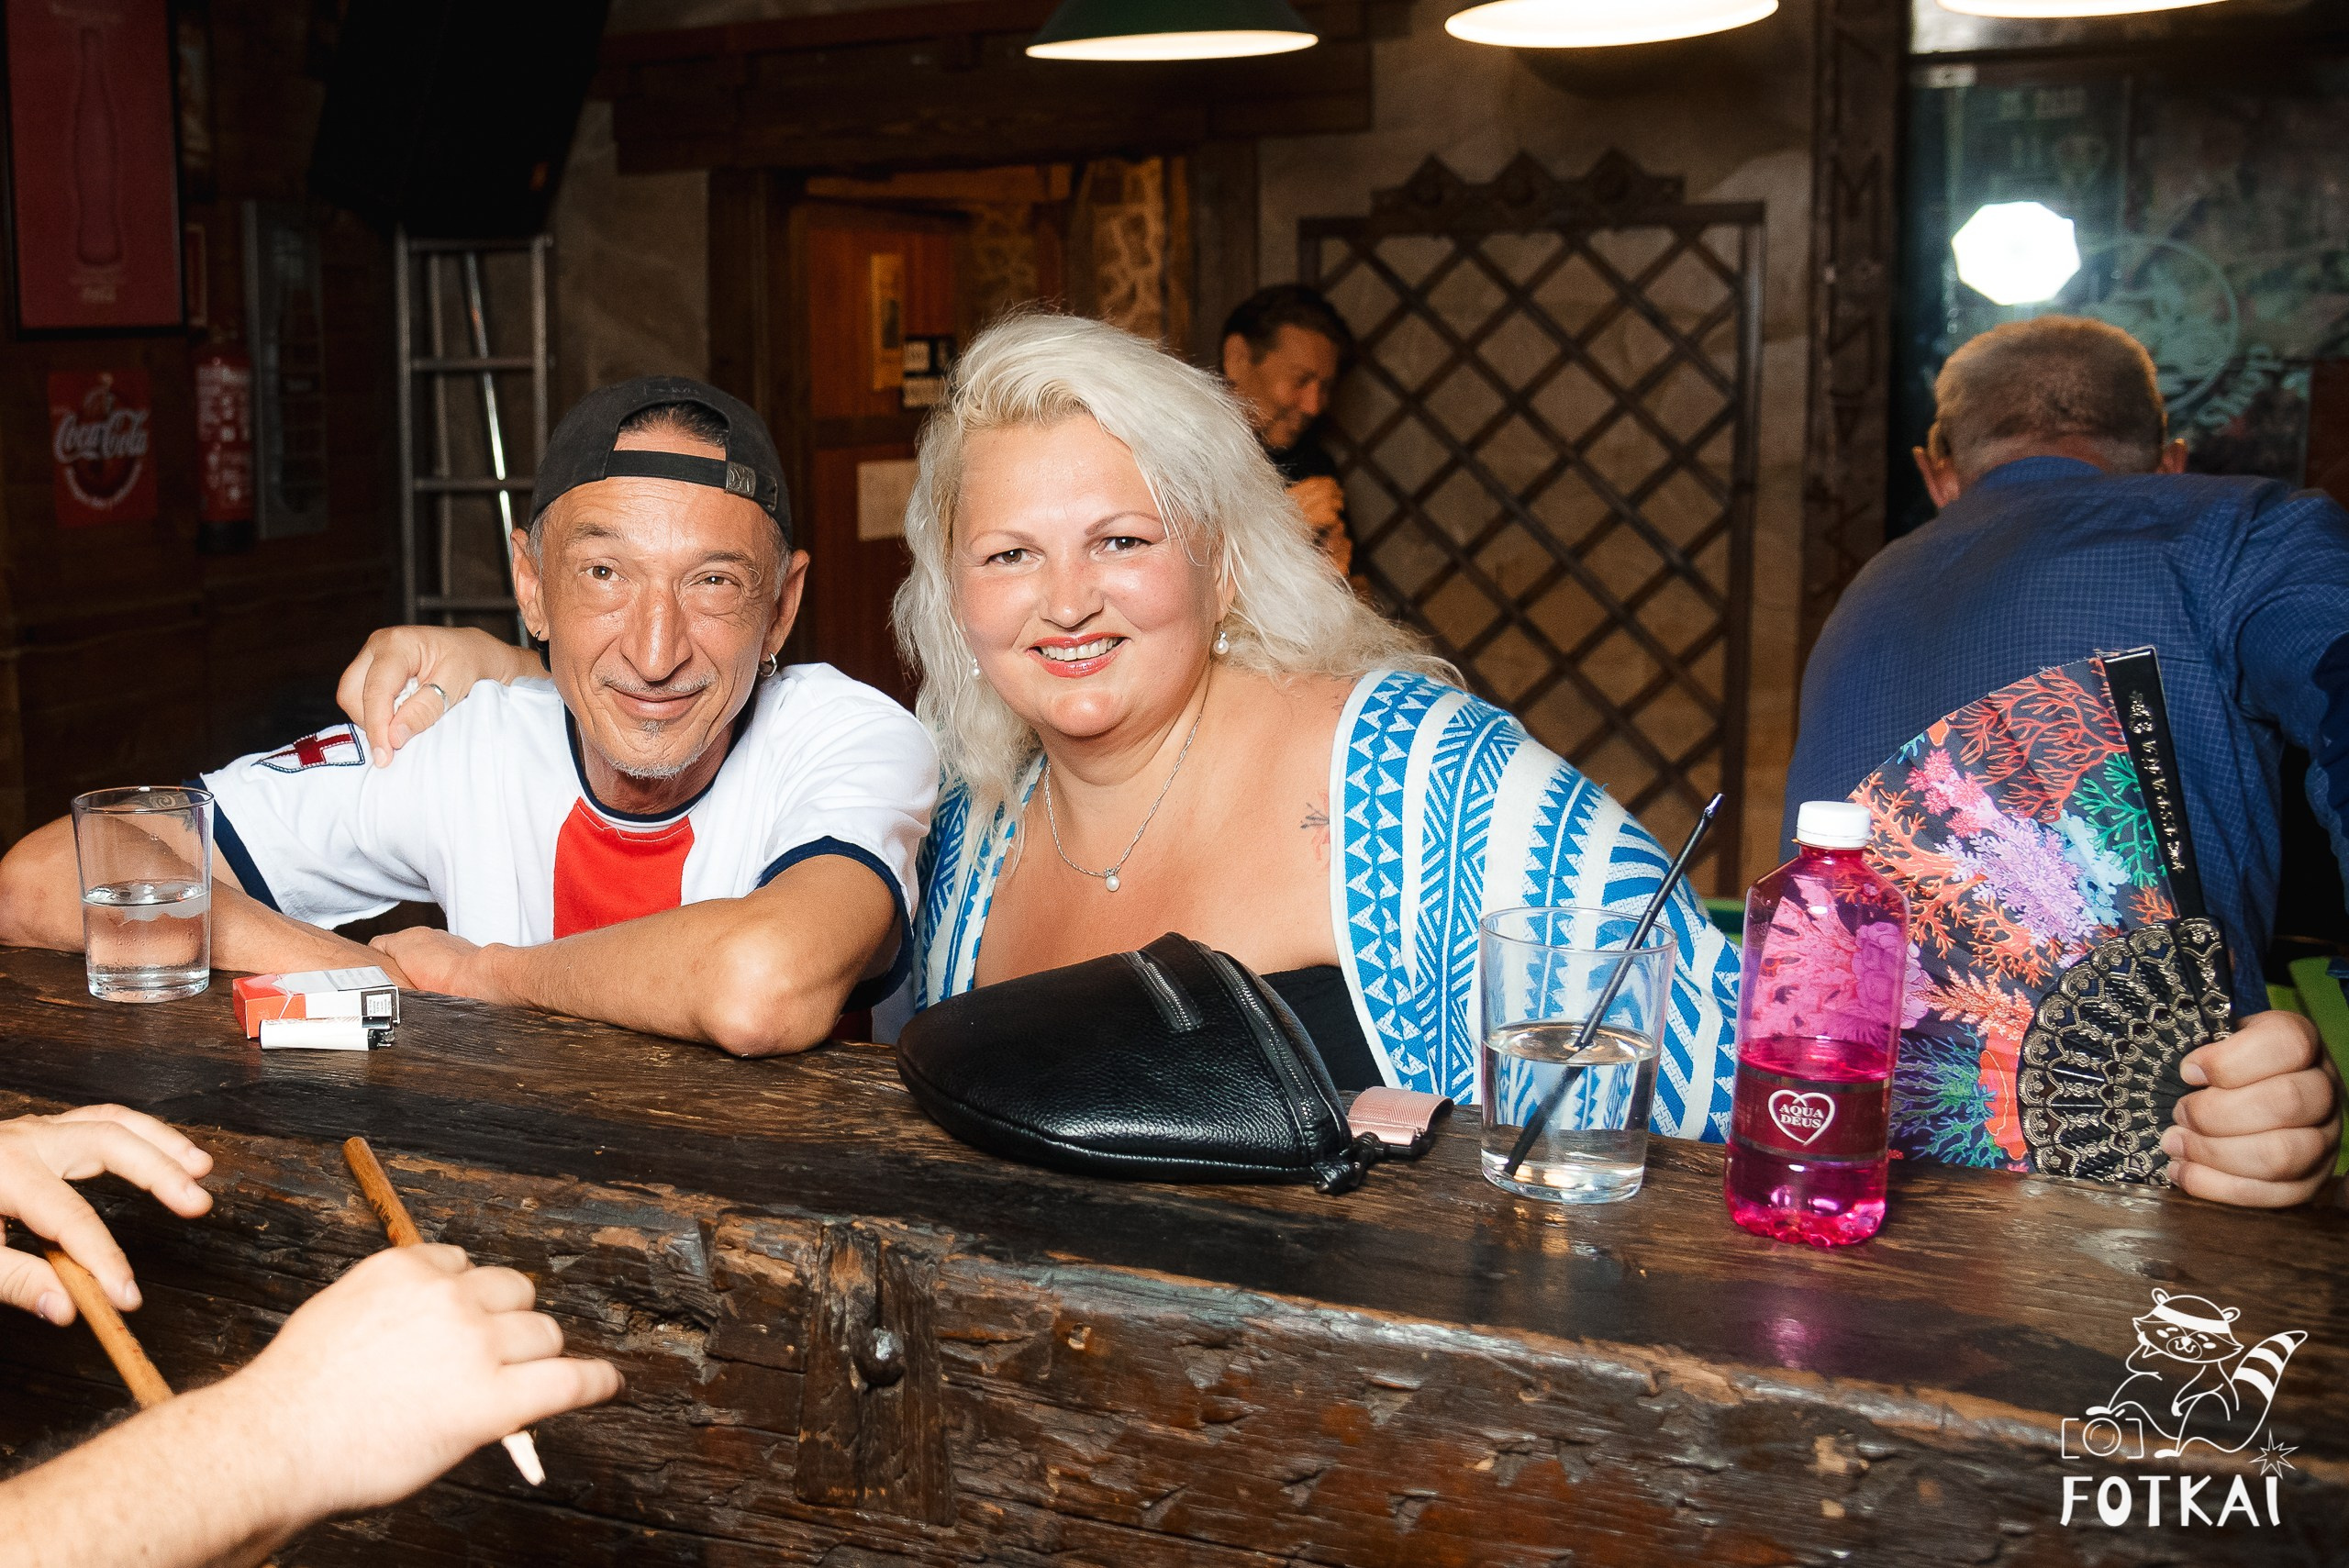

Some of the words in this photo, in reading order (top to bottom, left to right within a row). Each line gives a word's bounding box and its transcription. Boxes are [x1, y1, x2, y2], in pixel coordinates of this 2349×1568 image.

[2141, 740, 2178, 839] ESPAÑA
[1778, 1103, 1824, 1120] AQUA
[1780, 1114, 1821, 1129] DEUS
